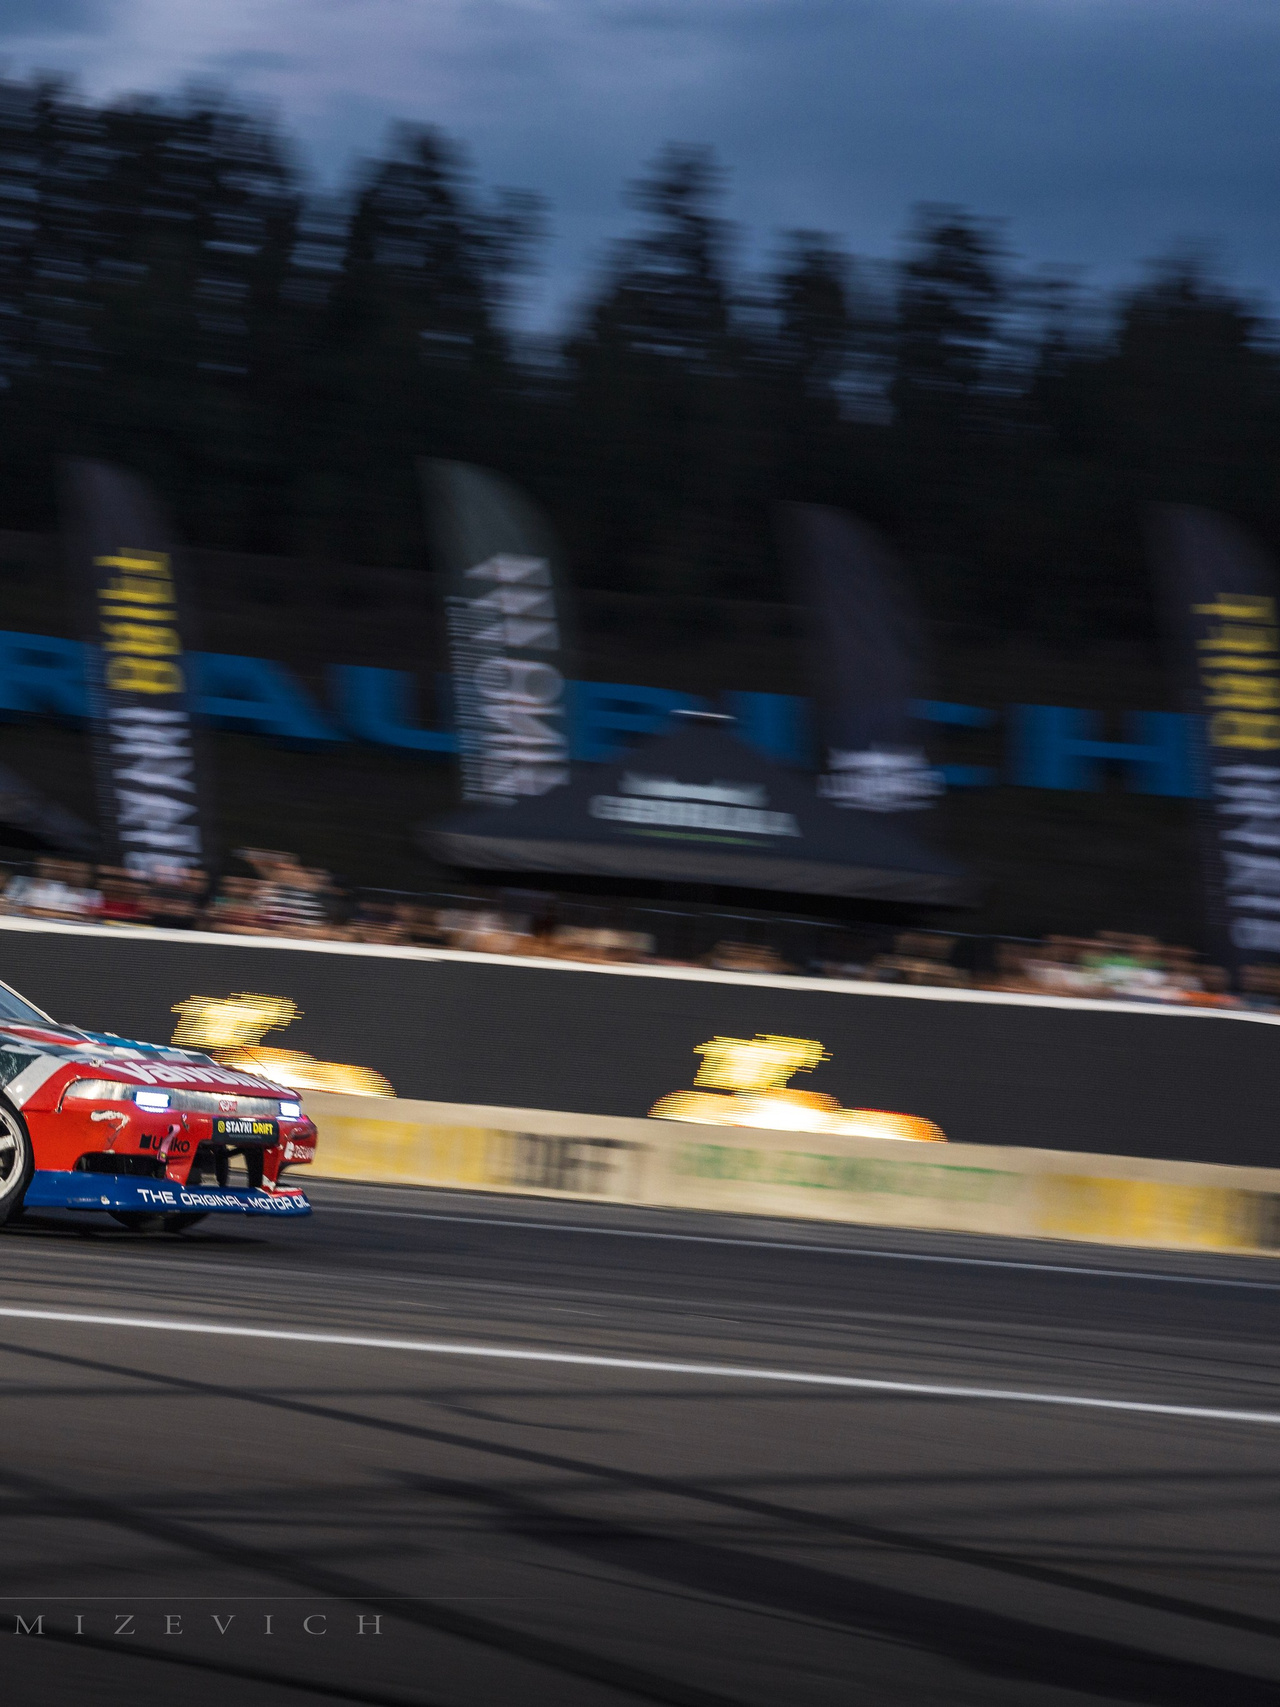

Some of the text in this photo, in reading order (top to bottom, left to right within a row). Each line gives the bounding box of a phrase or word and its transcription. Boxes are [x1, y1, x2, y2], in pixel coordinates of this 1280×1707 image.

[225, 1120, 273, 1135] STAYKI DRIFT
[137, 1188, 177, 1205] THE
[180, 1192, 248, 1208] ORIGINAL
[247, 1196, 292, 1211] MOTOR
